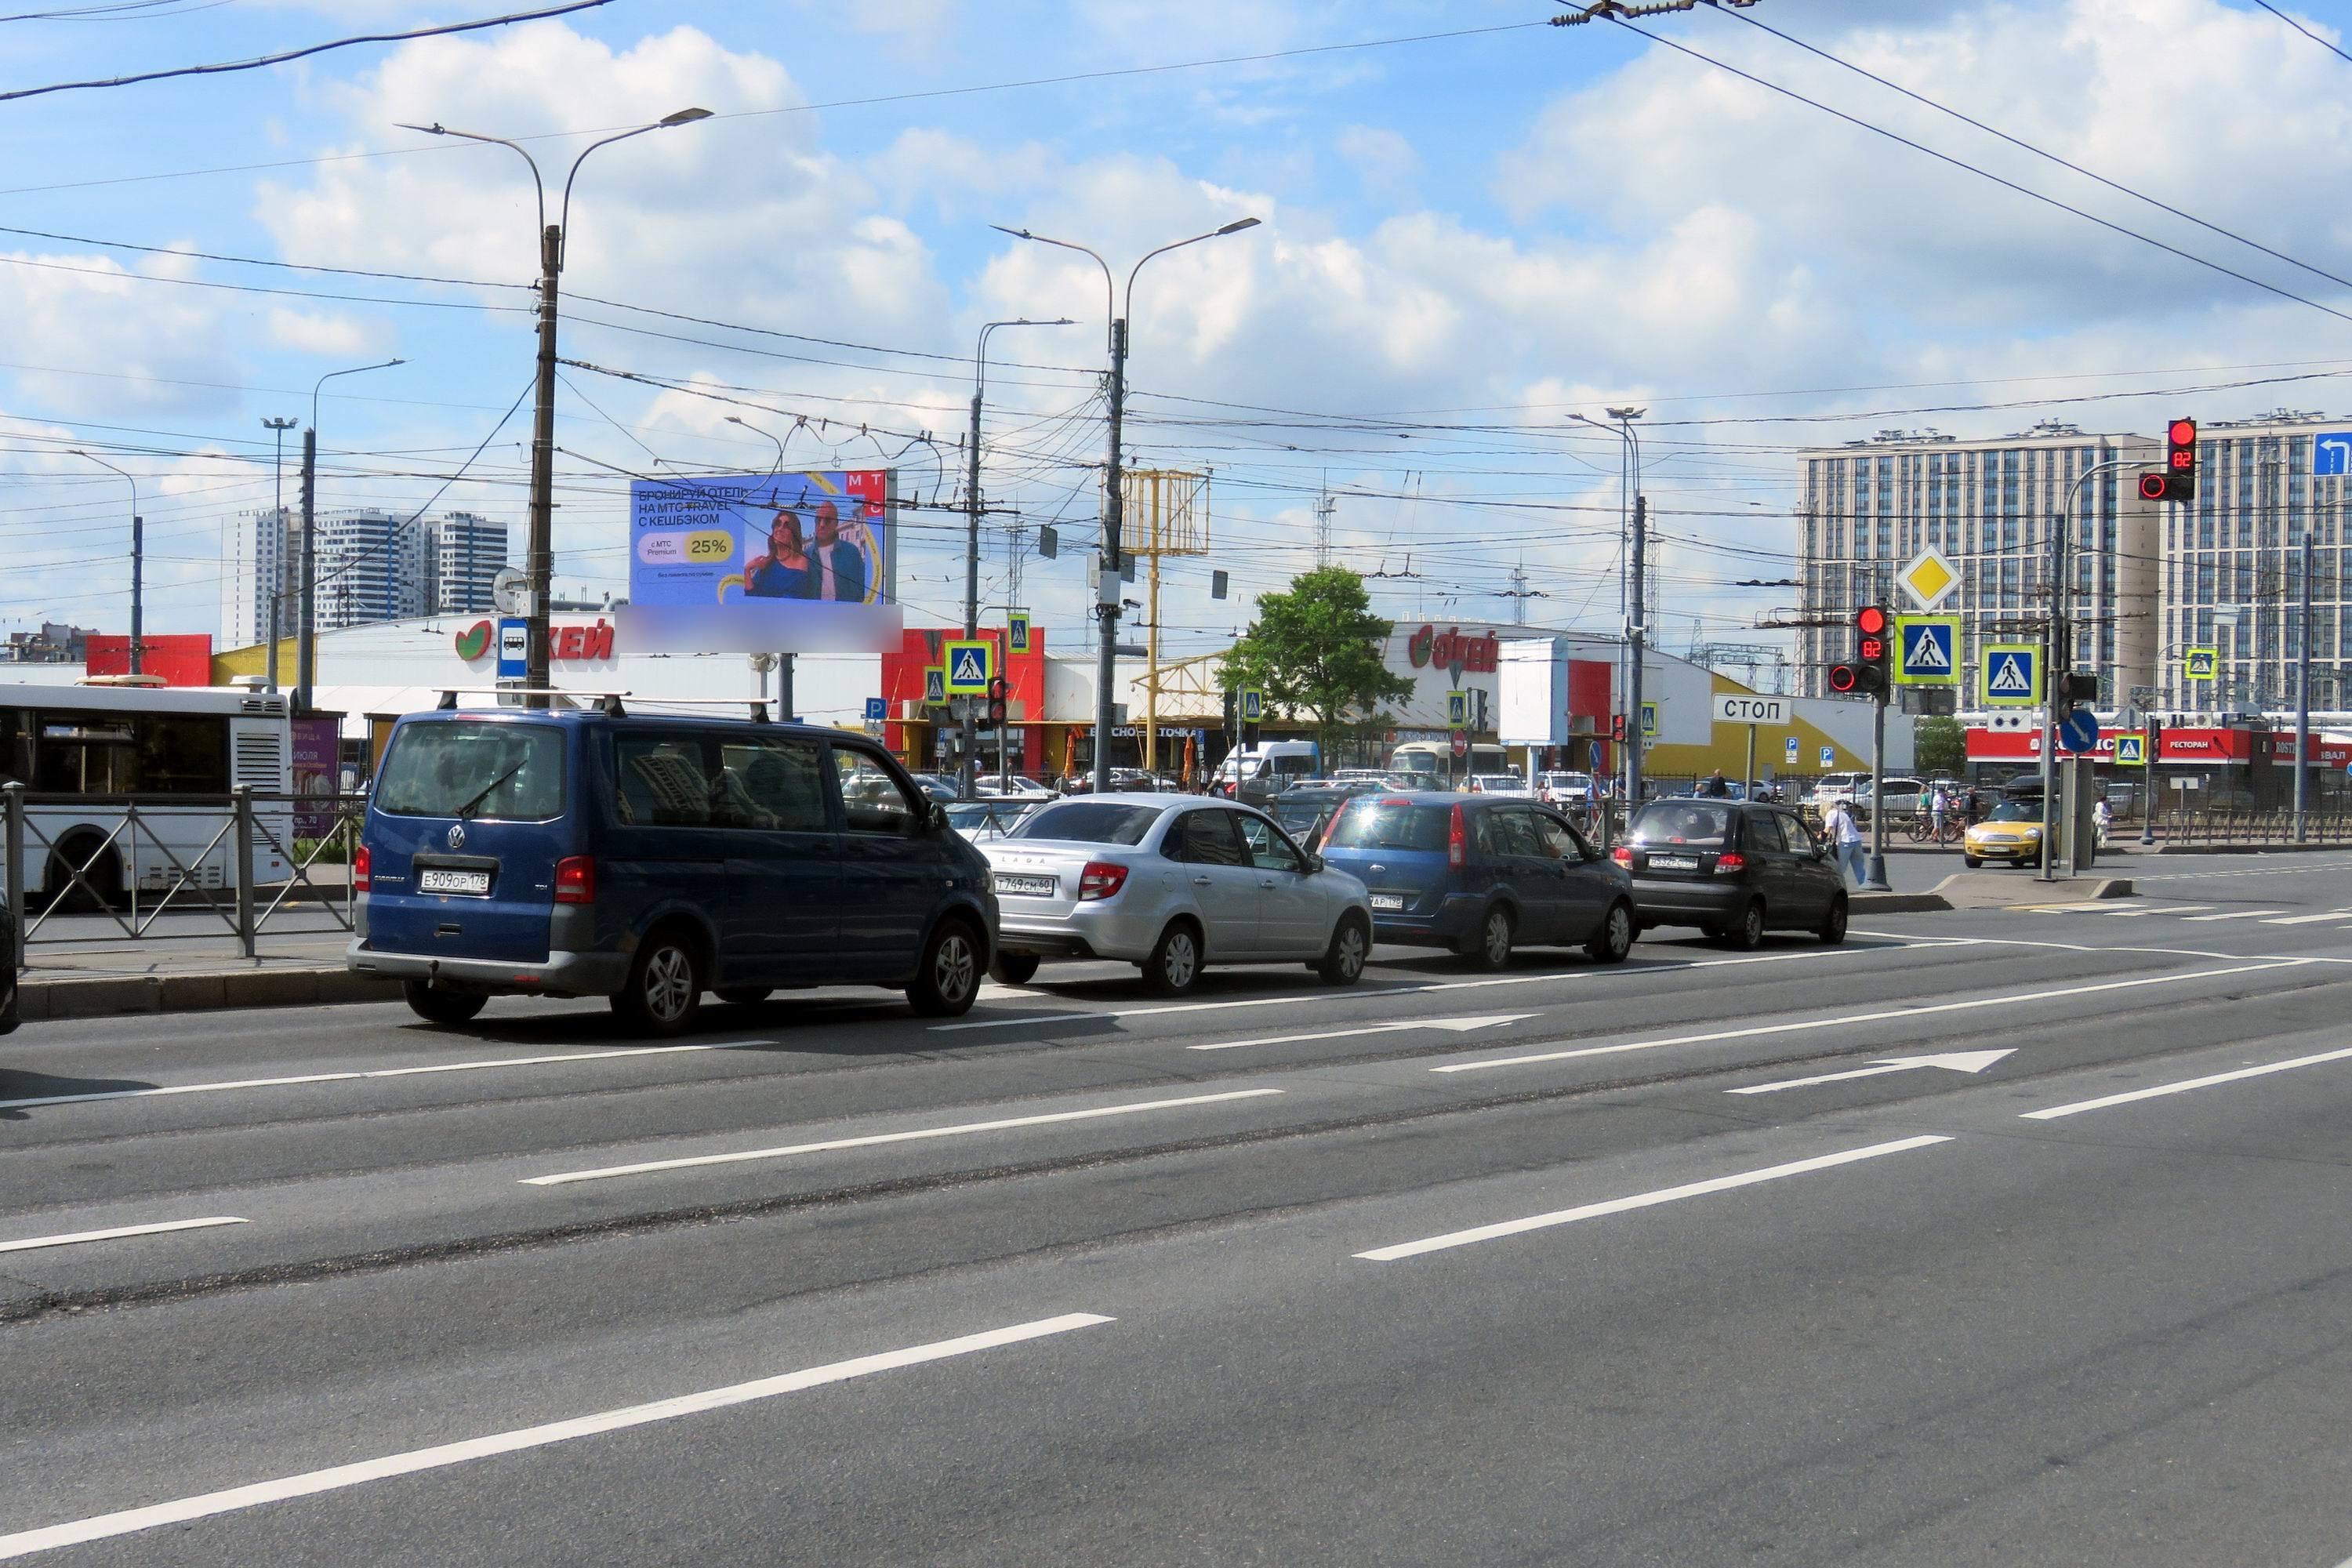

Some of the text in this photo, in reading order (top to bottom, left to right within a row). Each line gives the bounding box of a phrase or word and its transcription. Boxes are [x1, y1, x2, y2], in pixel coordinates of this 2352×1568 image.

[2174, 452, 2191, 467] 82
[639, 487, 748, 501] БРОНИРУЙ ОТЕЛЬ
[639, 500, 731, 514] НА МТС TRAVEL
[638, 514, 720, 527] С КЕШБЭКОМ
[691, 539, 727, 554] 25%
[1863, 641, 1882, 657] 82
[1724, 699, 1780, 720] СТОП
[2169, 741, 2209, 750] РЕСТОРАН
[293, 751, 318, 760] ИЮЛЯ
[470, 873, 487, 885] 178
[1039, 880, 1051, 889] 60
